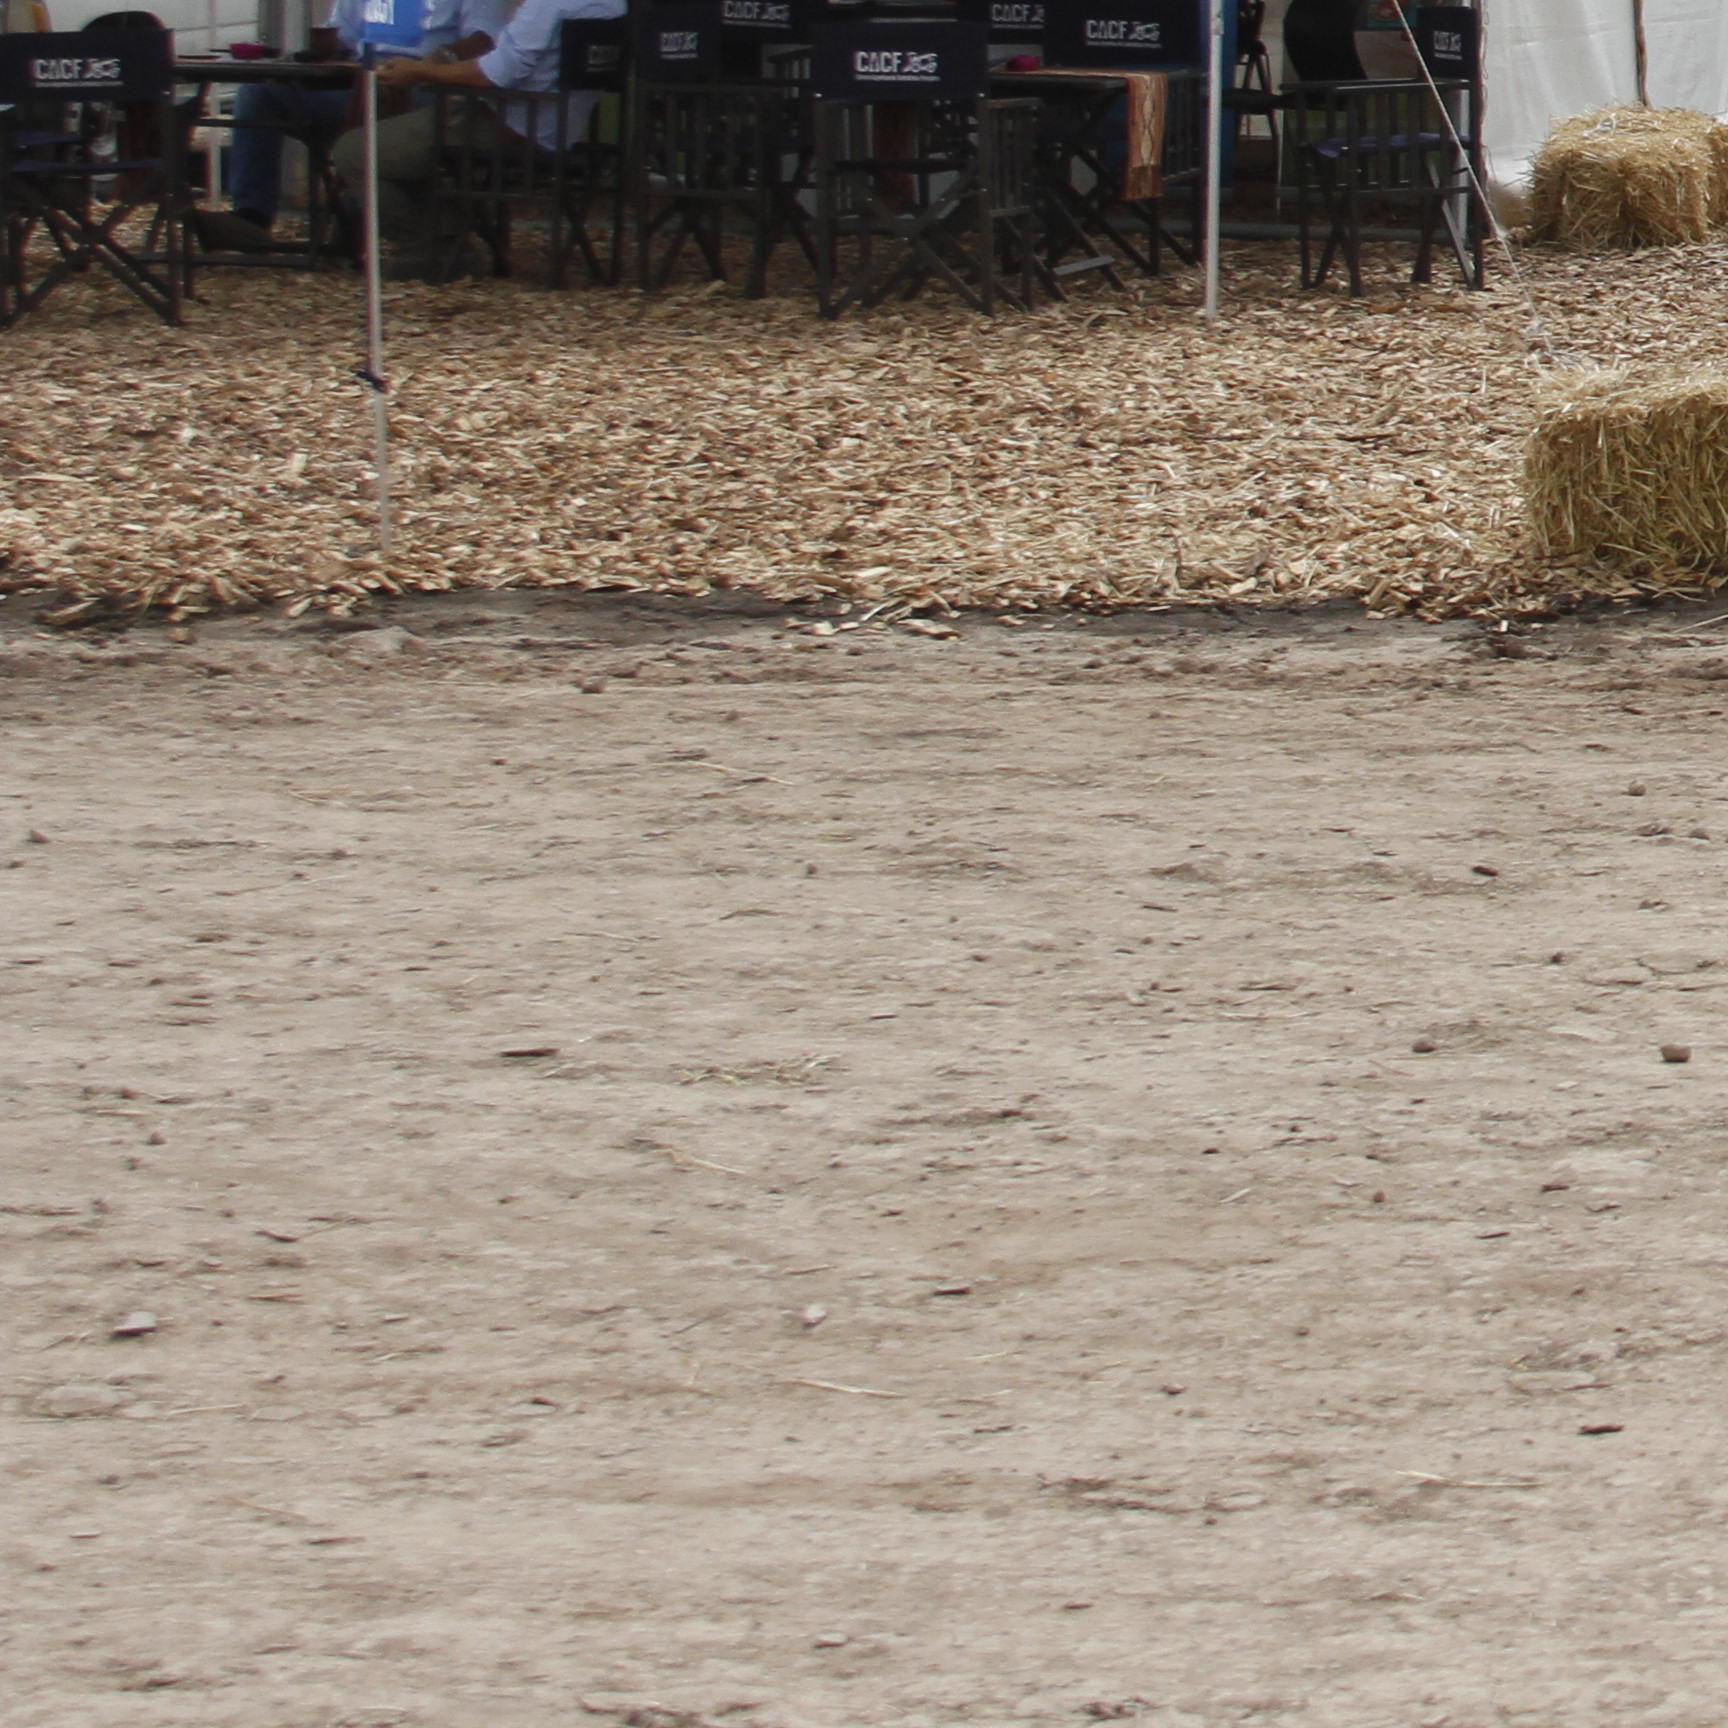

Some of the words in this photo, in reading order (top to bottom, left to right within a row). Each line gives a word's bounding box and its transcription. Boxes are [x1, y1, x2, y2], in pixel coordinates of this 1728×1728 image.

[724, 0, 761, 21] CACF
[991, 4, 1032, 22] CACF
[1086, 19, 1129, 40] CACF
[35, 58, 84, 80] CACF
[855, 50, 902, 73] CACF
